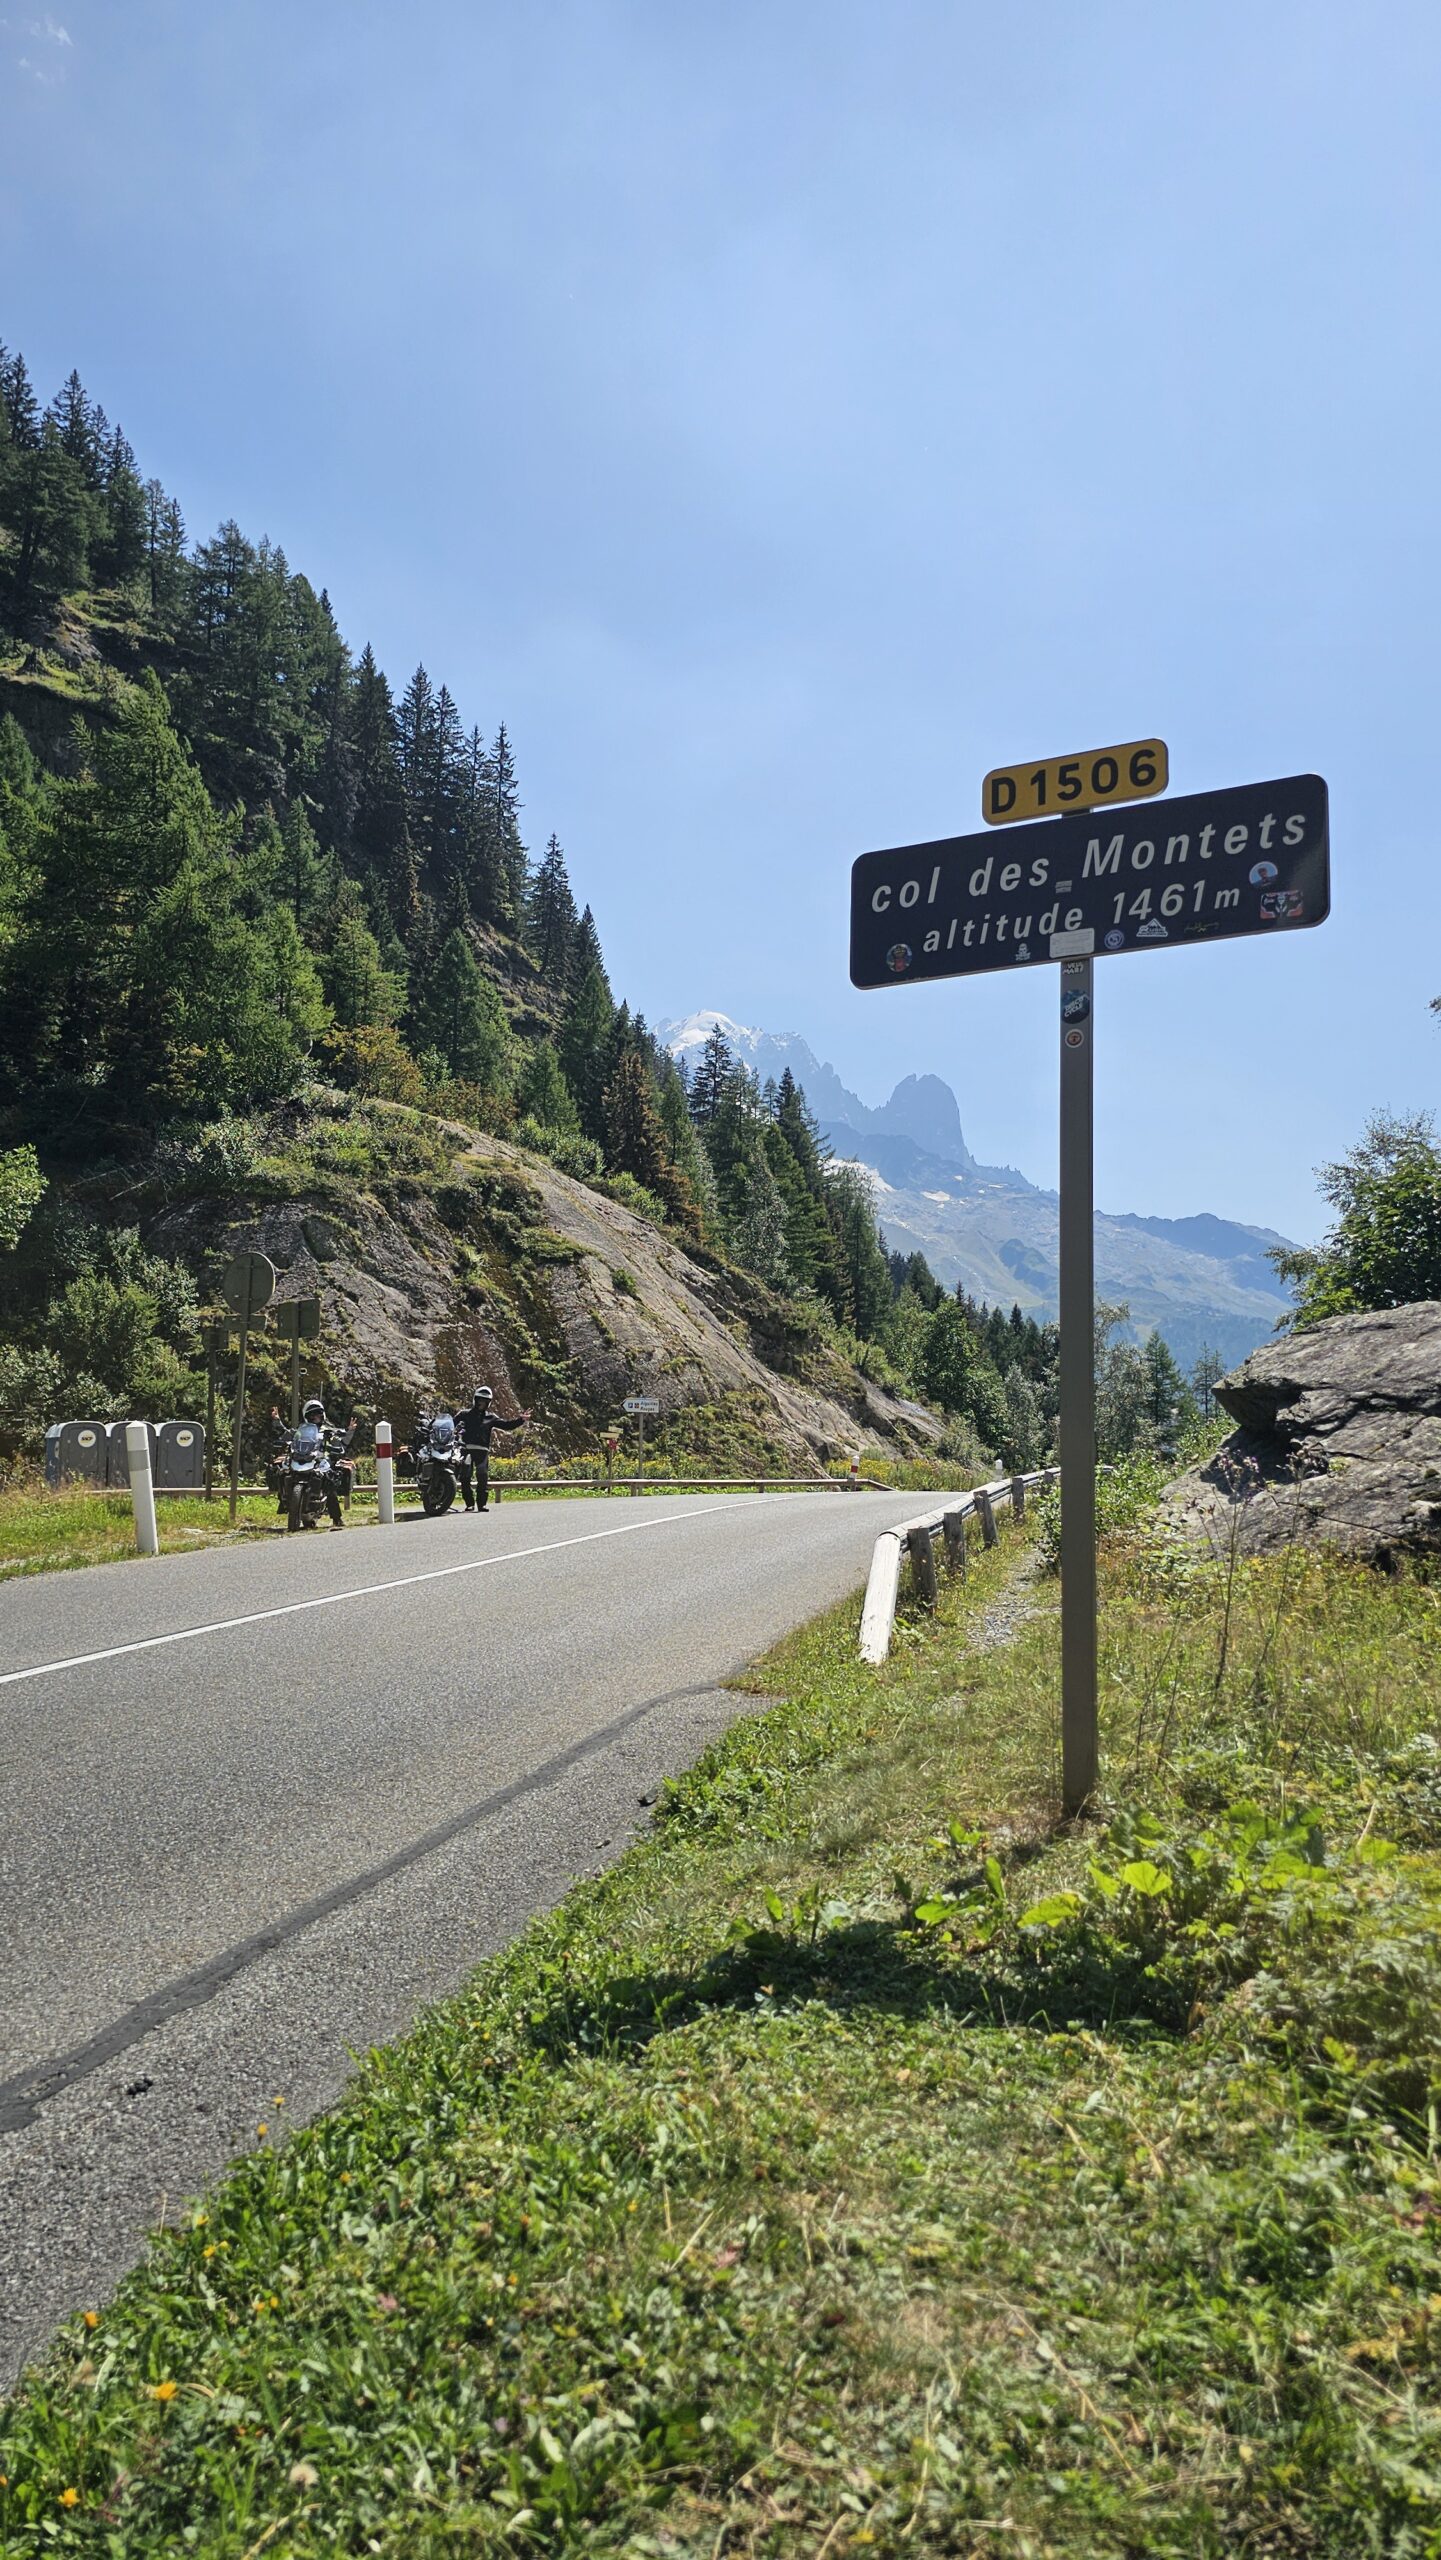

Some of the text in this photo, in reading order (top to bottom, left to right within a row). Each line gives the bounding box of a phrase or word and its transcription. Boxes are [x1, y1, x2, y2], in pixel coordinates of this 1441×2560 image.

[871, 813, 1306, 913] col des Montets
[922, 902, 1083, 953] altitude
